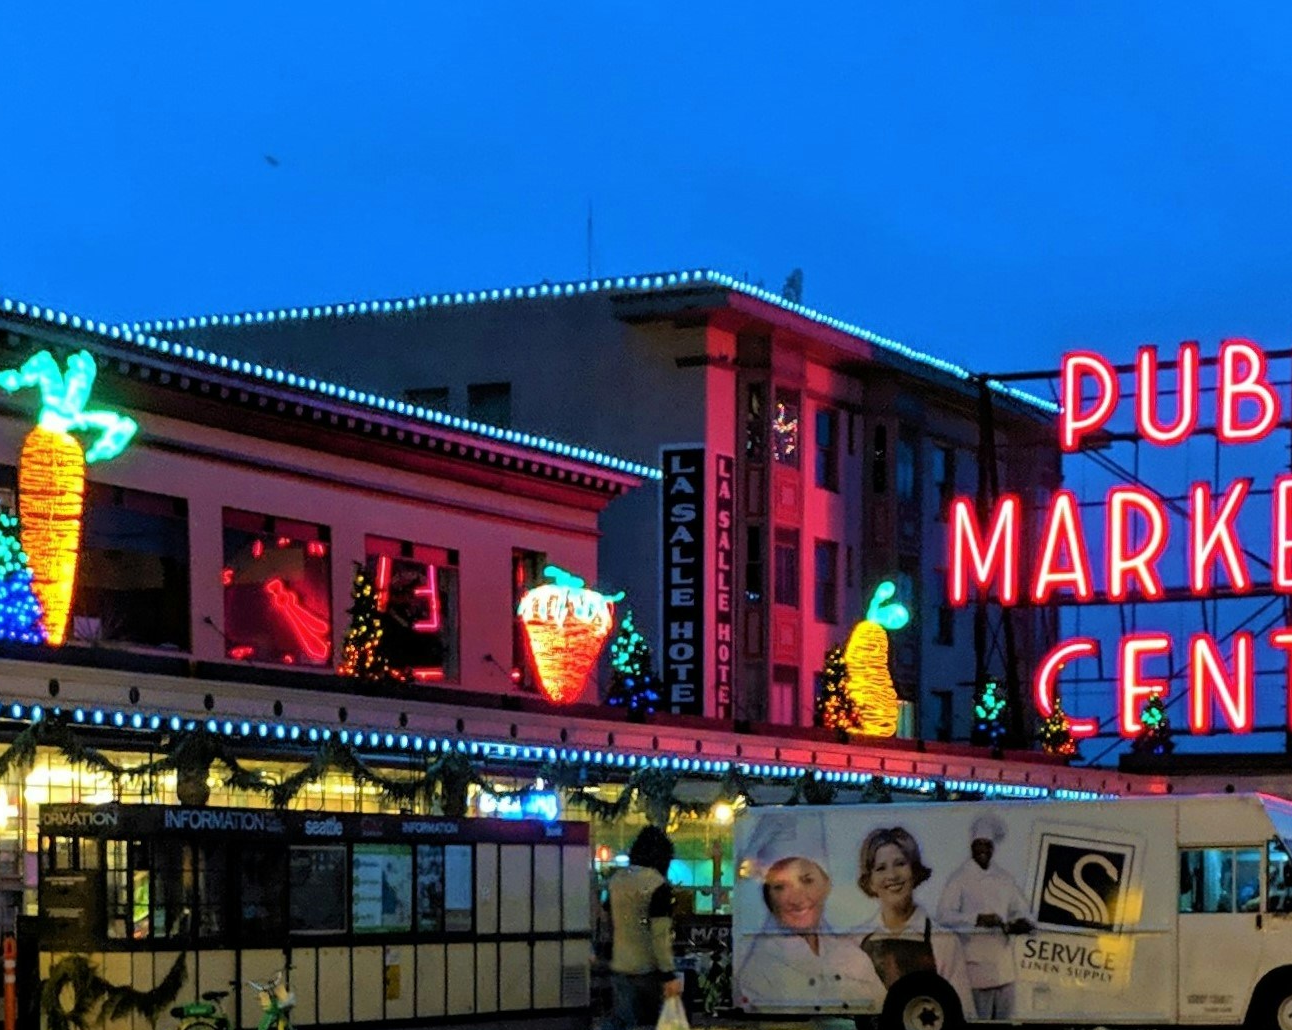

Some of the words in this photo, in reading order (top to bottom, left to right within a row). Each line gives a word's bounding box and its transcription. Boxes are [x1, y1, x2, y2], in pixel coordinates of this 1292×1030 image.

[670, 455, 695, 495] LA
[718, 459, 731, 499] LA
[669, 503, 696, 607] SALLE
[718, 511, 732, 613] SALLE
[43, 811, 118, 826] ORMATION
[164, 809, 265, 831] INFORMATION
[401, 821, 459, 835] INFORMATION
[1023, 938, 1116, 971] SERVICE
[1021, 959, 1059, 974] LINEN
[1066, 966, 1114, 984] SUPPLY
